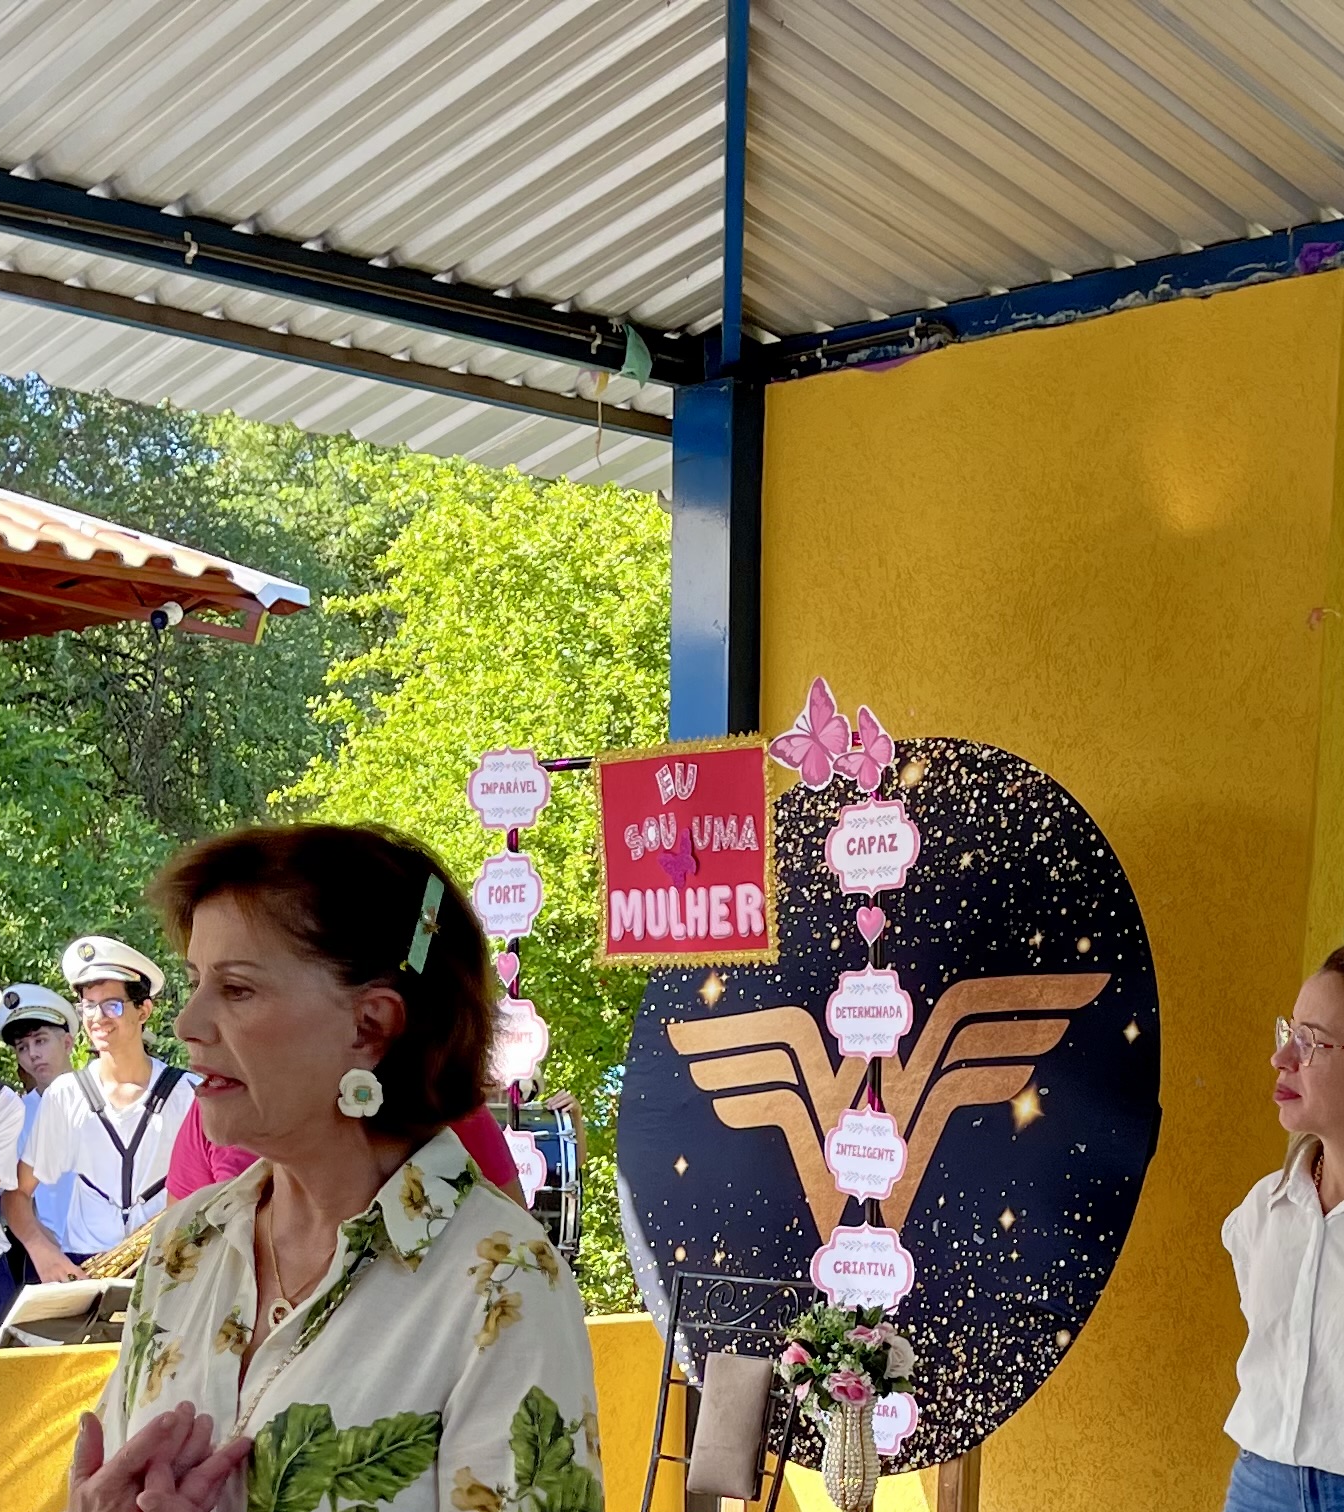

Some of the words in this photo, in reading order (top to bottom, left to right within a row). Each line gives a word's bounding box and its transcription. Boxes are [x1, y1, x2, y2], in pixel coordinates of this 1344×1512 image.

[480, 777, 538, 795] IMPARÁVEL
[655, 762, 698, 805] EU
[624, 812, 677, 861] SOU
[692, 814, 759, 852] UMA
[846, 833, 899, 856] CAPAZ
[488, 884, 526, 905] FORTE
[610, 883, 765, 941] MULHER
[835, 1006, 903, 1020] DETERMINADA
[835, 1142, 896, 1162] INTELIGENTE
[833, 1260, 897, 1278] CRIATIVA
